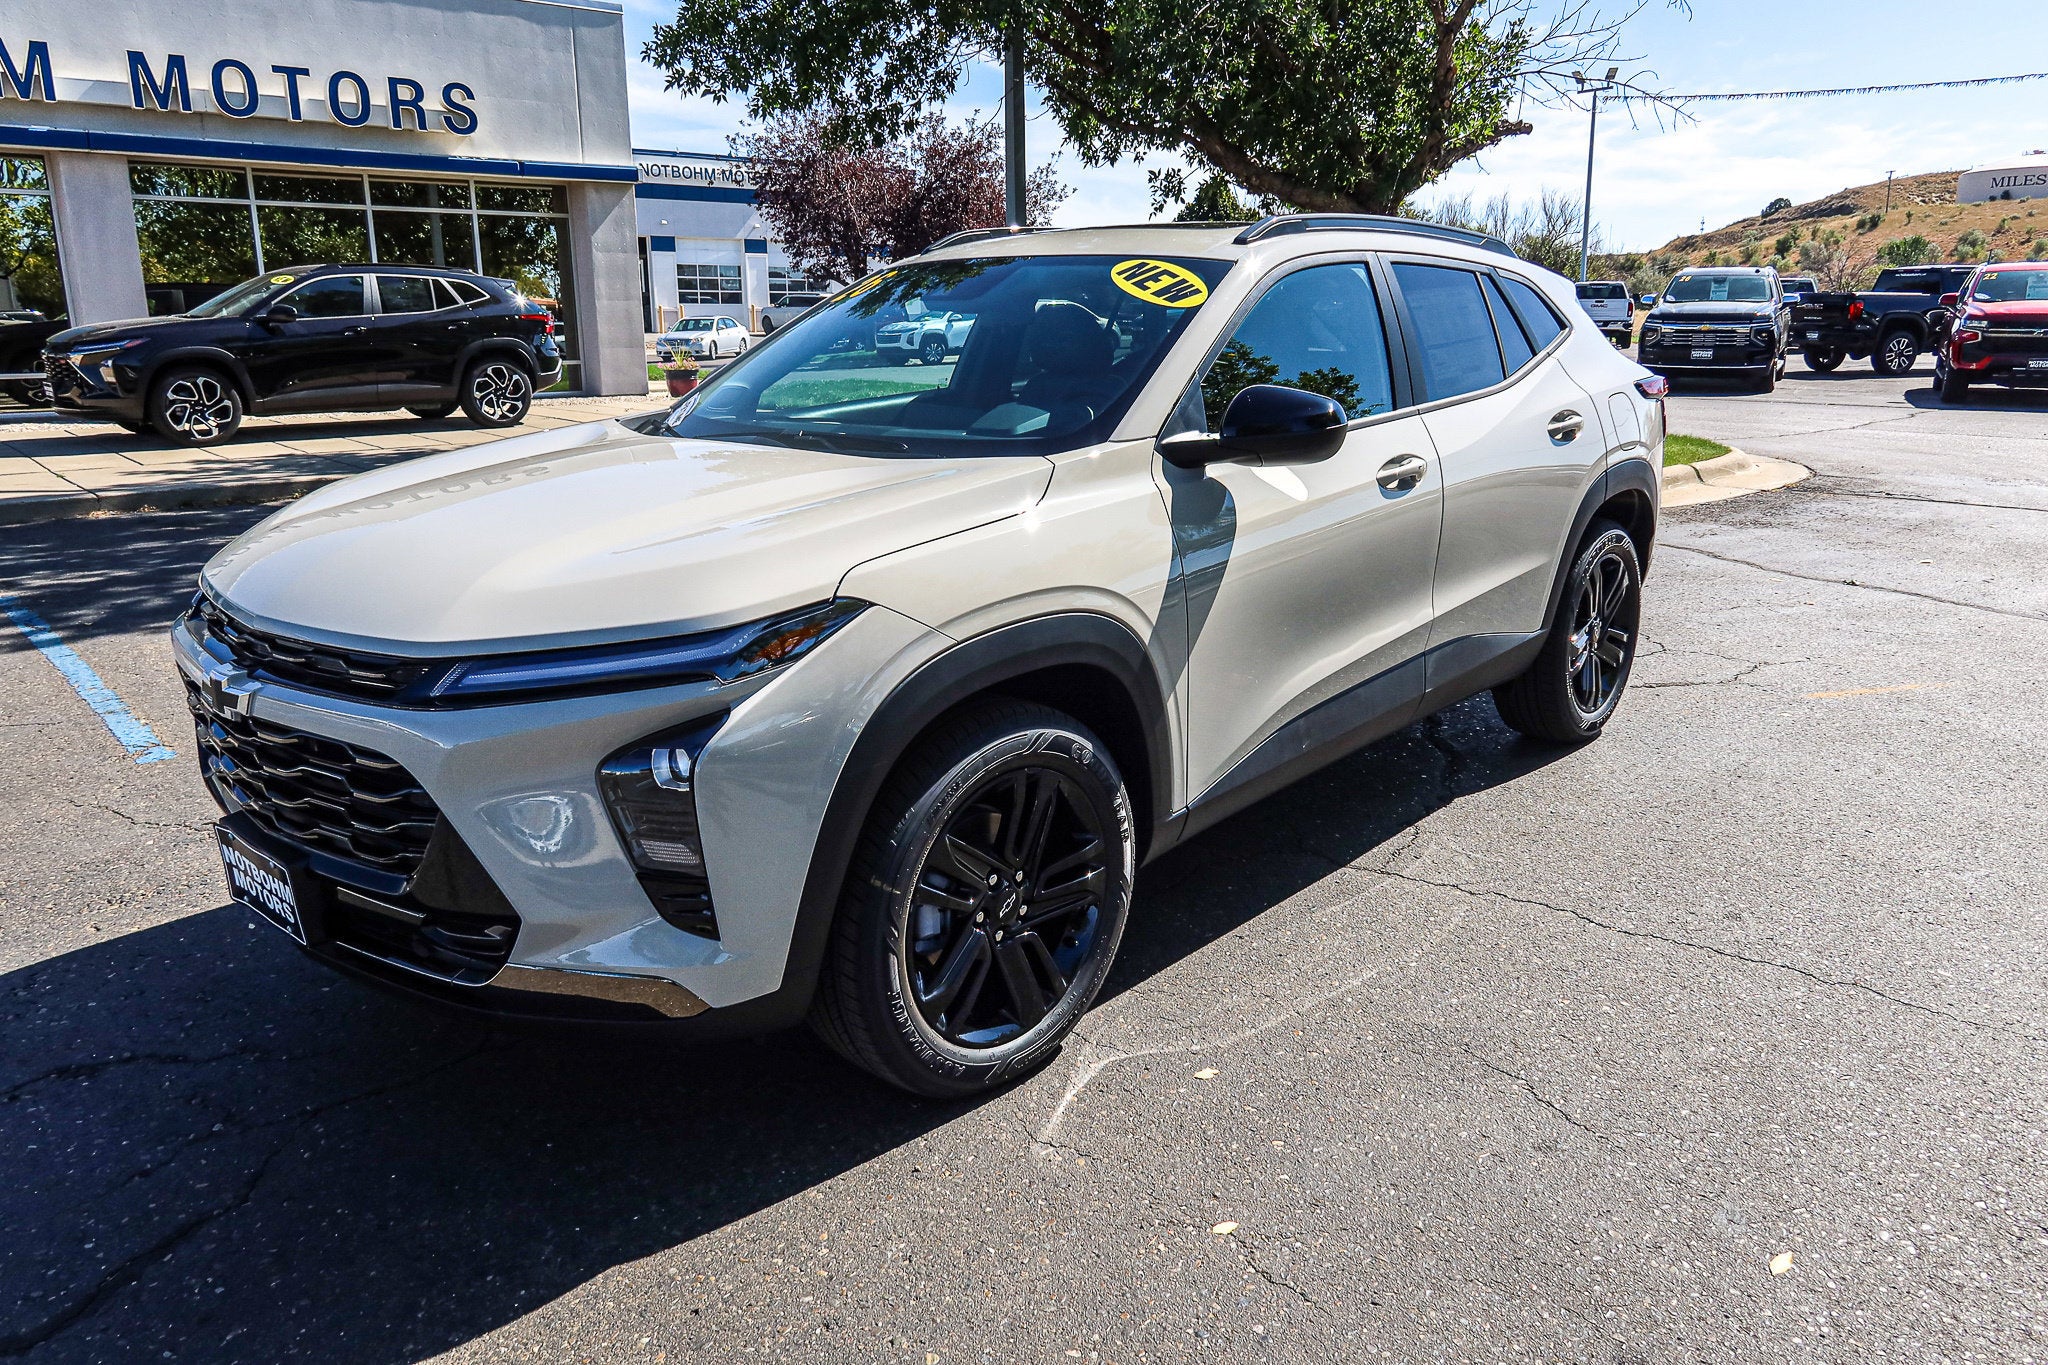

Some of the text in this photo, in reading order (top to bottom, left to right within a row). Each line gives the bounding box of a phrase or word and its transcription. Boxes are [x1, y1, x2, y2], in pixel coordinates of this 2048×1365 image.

[126, 49, 479, 137] MOTORS
[639, 163, 755, 184] NOTBOHM MOT
[1990, 174, 2047, 188] MILES
[1116, 261, 1203, 304] NEW
[1983, 272, 1998, 280] 22
[221, 843, 295, 906] NOTBOHM
[233, 867, 295, 924] MOTORS
